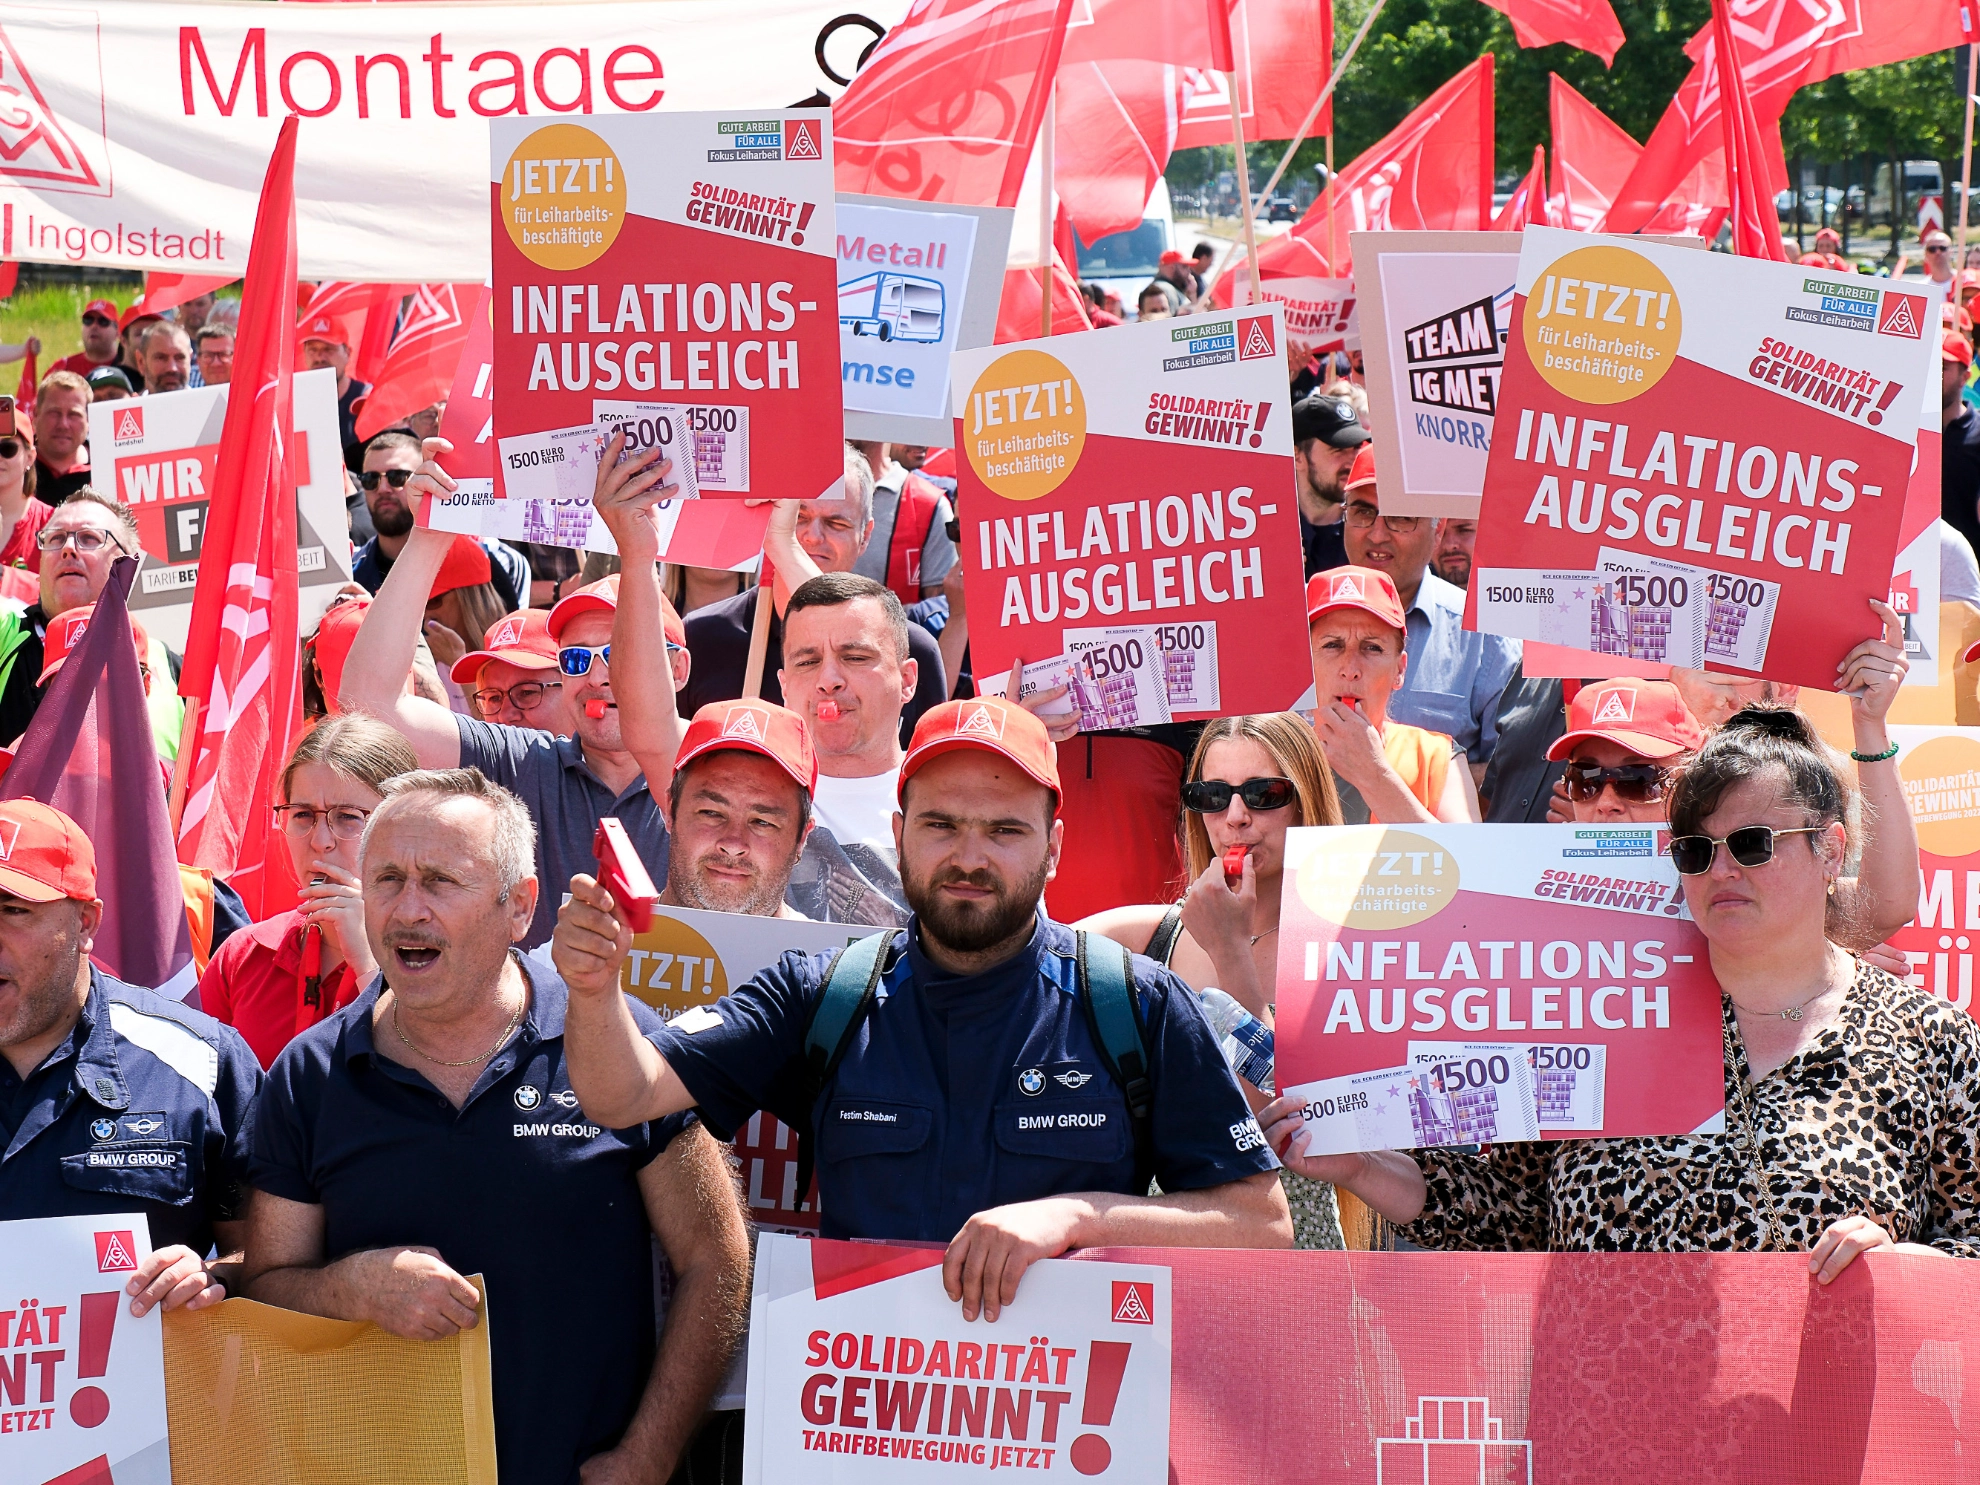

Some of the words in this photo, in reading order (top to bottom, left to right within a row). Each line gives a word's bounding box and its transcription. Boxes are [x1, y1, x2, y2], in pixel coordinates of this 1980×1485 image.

[720, 122, 744, 133] GUTE
[745, 121, 778, 132] ARBEIT
[737, 134, 755, 147] FÜR
[756, 136, 778, 147] ALLE
[710, 151, 734, 161] Fokus
[735, 149, 778, 161] Leiharbeit
[510, 157, 614, 202] JETZT!
[690, 181, 797, 219] SOLIDARITÄT
[514, 206, 533, 224] für
[535, 206, 614, 224] Leiharbeits-
[27, 214, 226, 262] Ingolstadt
[523, 227, 603, 248] beschäftigte
[836, 235, 947, 269] Metall
[1537, 274, 1671, 331] JETZT!
[1806, 281, 1836, 296] GUTE
[1837, 285, 1876, 300] ARBEIT
[511, 281, 817, 335] INFLATIONS-
[1788, 308, 1818, 322] Fokus
[1819, 312, 1871, 330] Leiharbeit
[1824, 298, 1846, 312] FÜR
[1847, 303, 1874, 315] ALLE
[1174, 328, 1198, 341] GUTE
[1199, 323, 1231, 337] ARBEIT
[1192, 339, 1210, 352] FÜR
[1211, 337, 1233, 349] ALLE
[1407, 304, 1494, 360] TEAM
[1538, 326, 1561, 346] für
[1563, 331, 1661, 361] Leiharbeits-
[527, 340, 800, 392] AUSGLEICH
[1165, 358, 1190, 371] Fokus
[1191, 351, 1234, 367] Leiharbeit
[1544, 349, 1645, 383] beschäftigte
[1758, 337, 1881, 395] SOLIDARITÄT
[1413, 370, 1442, 401] IG
[685, 407, 737, 432] 1500
[972, 378, 1073, 436] JETZT!
[1149, 392, 1253, 421] SOLIDARITÄT
[114, 438, 145, 449] Landshut
[540, 446, 564, 457] EURO
[977, 439, 996, 457] für
[997, 430, 1075, 455] Leiharbeits-
[507, 450, 540, 470] 1500
[541, 454, 565, 464] NETTO
[987, 453, 1066, 479] beschäftigte
[1514, 408, 1883, 514] INFLATIONS-
[121, 457, 206, 506] WIR
[979, 486, 1278, 571] INFLATIONS-
[1523, 474, 1852, 576] AUSGLEICH
[1000, 546, 1265, 628] AUSGLEICH
[1485, 586, 1523, 603] 1500
[1525, 587, 1555, 596] EURO
[1525, 595, 1555, 604] NETTO
[1614, 575, 1689, 608] 1500
[1706, 573, 1765, 608] 1500
[1154, 624, 1205, 651] 1500
[1081, 638, 1144, 682] 1500
[1019, 681, 1037, 693] URO
[1579, 830, 1609, 839] GUTE
[1610, 830, 1649, 839] ARBEIT
[1600, 838, 1621, 848] FÜR
[1622, 839, 1650, 848] ALLE
[1565, 848, 1595, 857] Fokus
[1597, 848, 1650, 857] Leiharbeit
[1541, 868, 1670, 897] SOLIDARITÄT
[630, 950, 715, 995] TZT!
[1303, 940, 1694, 982] INFLATIONS-
[1322, 985, 1670, 1034] AUSGLEICH
[1527, 1046, 1591, 1070] 1500
[1429, 1054, 1511, 1094] 1500
[1337, 1091, 1367, 1105] EURO
[1338, 1100, 1369, 1114] NETTO
[840, 1110, 863, 1120] Festim
[863, 1111, 898, 1122] Shabani
[1018, 1115, 1055, 1129] BMW
[1057, 1113, 1107, 1127] GROUP
[513, 1124, 550, 1137] BMW
[551, 1124, 601, 1139] GROUP
[89, 1154, 125, 1165] BMW
[127, 1153, 177, 1165] GROUP
[804, 1329, 1077, 1387] SOLIDARITÄT
[802, 1429, 987, 1465] TARIFBEWEGUNG
[989, 1445, 1056, 1471] JETZT
